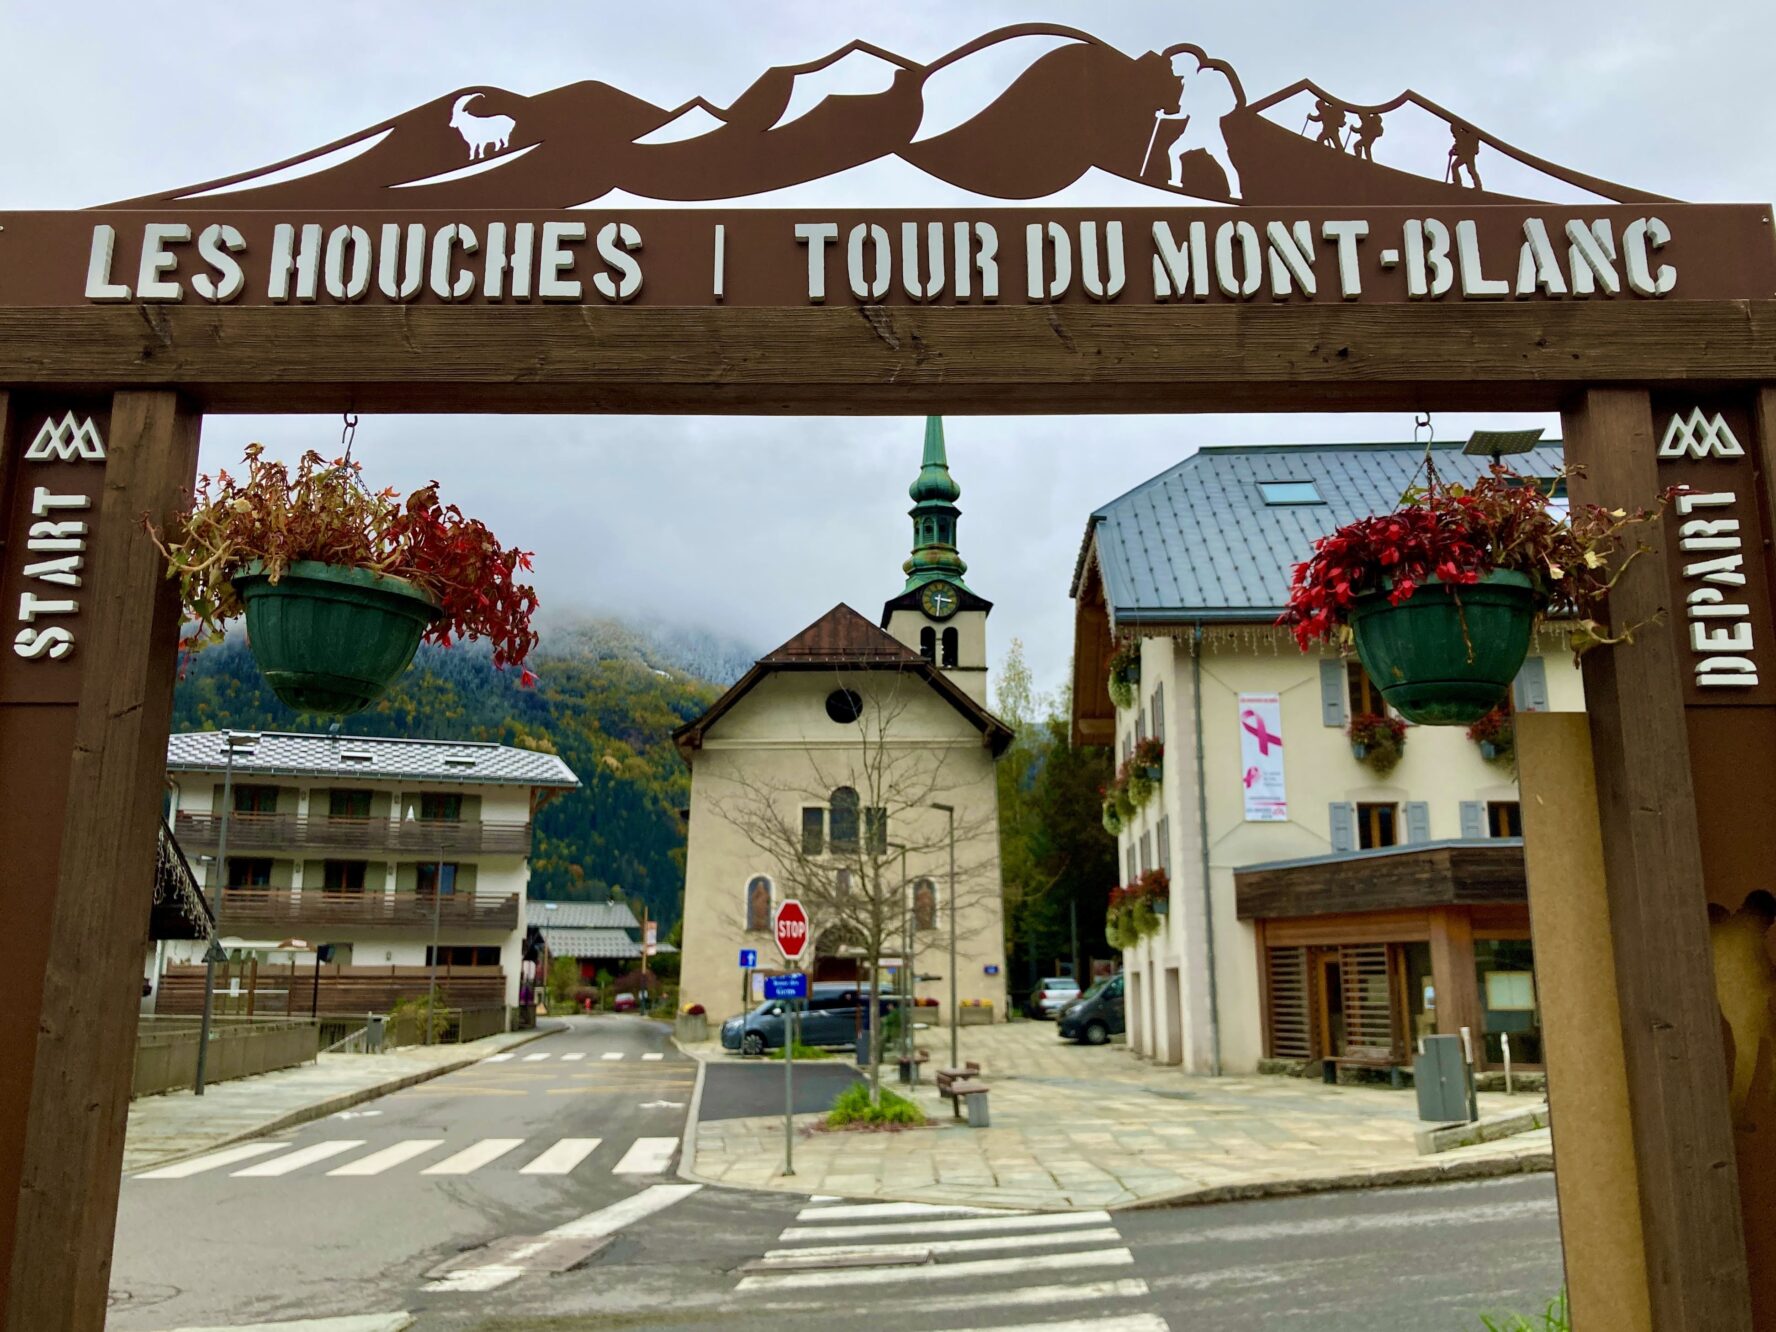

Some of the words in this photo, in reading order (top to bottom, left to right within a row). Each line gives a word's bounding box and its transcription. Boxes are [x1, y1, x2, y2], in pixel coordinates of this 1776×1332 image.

[84, 222, 247, 302] LES
[267, 222, 645, 302] HOUCHES
[794, 221, 999, 302] TOUR
[1026, 221, 1127, 302] DU
[1152, 216, 1678, 300] MONT-BLANC
[13, 486, 92, 661] START
[1674, 484, 1760, 688] DEPART
[778, 920, 805, 938] STOP
